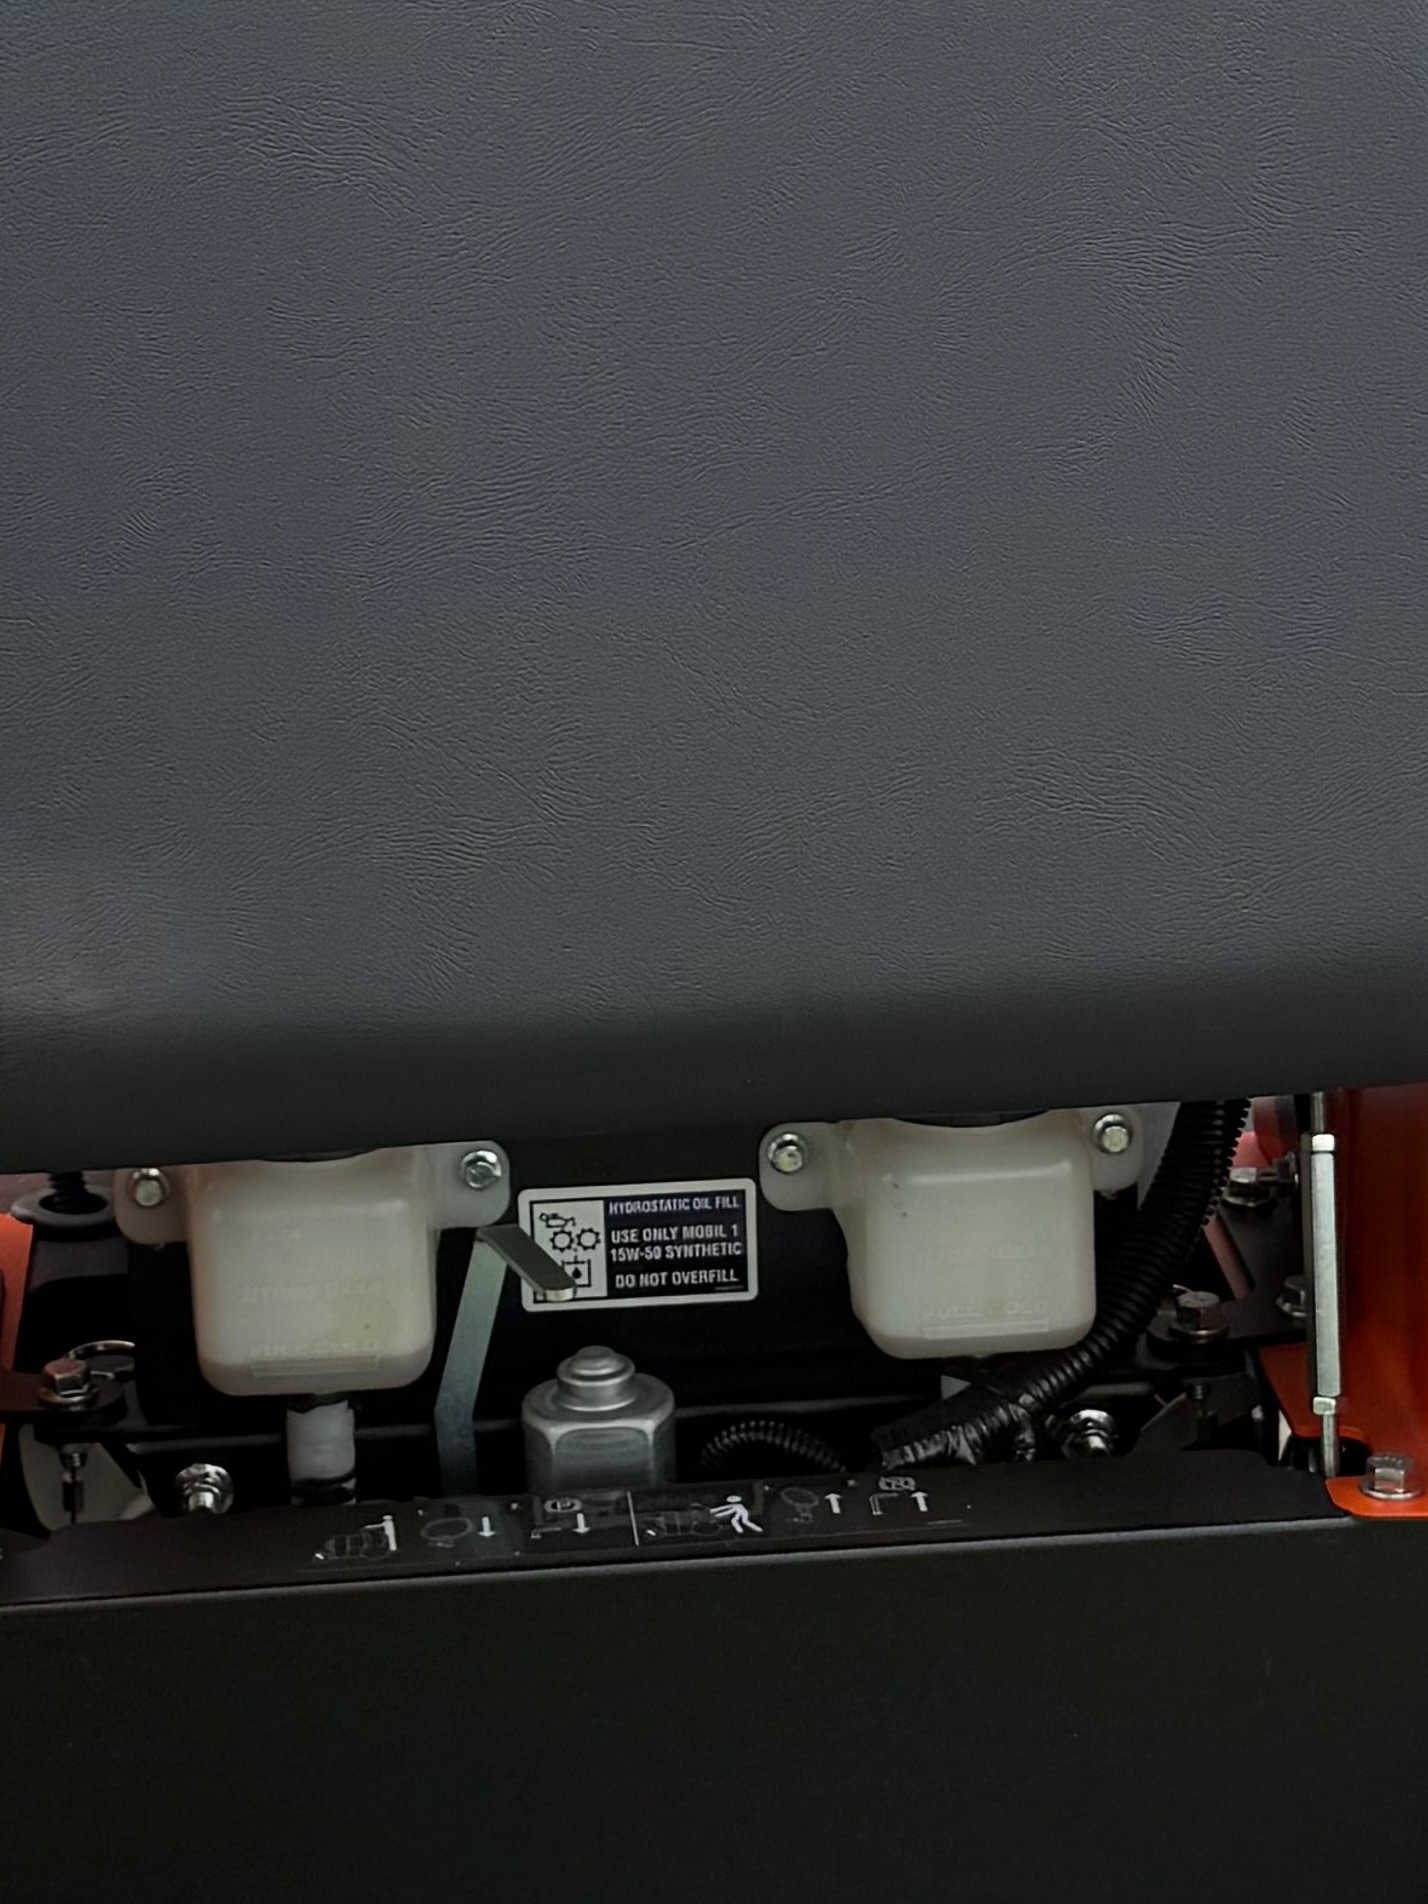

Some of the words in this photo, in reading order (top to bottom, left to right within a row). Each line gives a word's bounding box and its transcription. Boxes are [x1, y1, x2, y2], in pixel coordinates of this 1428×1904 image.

[609, 1198, 690, 1215] HYDROSTATIC
[692, 1197, 712, 1210] OIL
[715, 1195, 740, 1209] FILL
[611, 1228, 639, 1244] USE
[642, 1226, 679, 1242] ONLY
[682, 1223, 727, 1240] MOBIL
[731, 1223, 739, 1238] 1
[610, 1245, 662, 1263] 15W-50
[665, 1241, 743, 1259] SYNTHETIC
[615, 1274, 636, 1289] DO
[639, 1271, 669, 1288] NOT
[672, 1268, 740, 1286] OVERFILL
